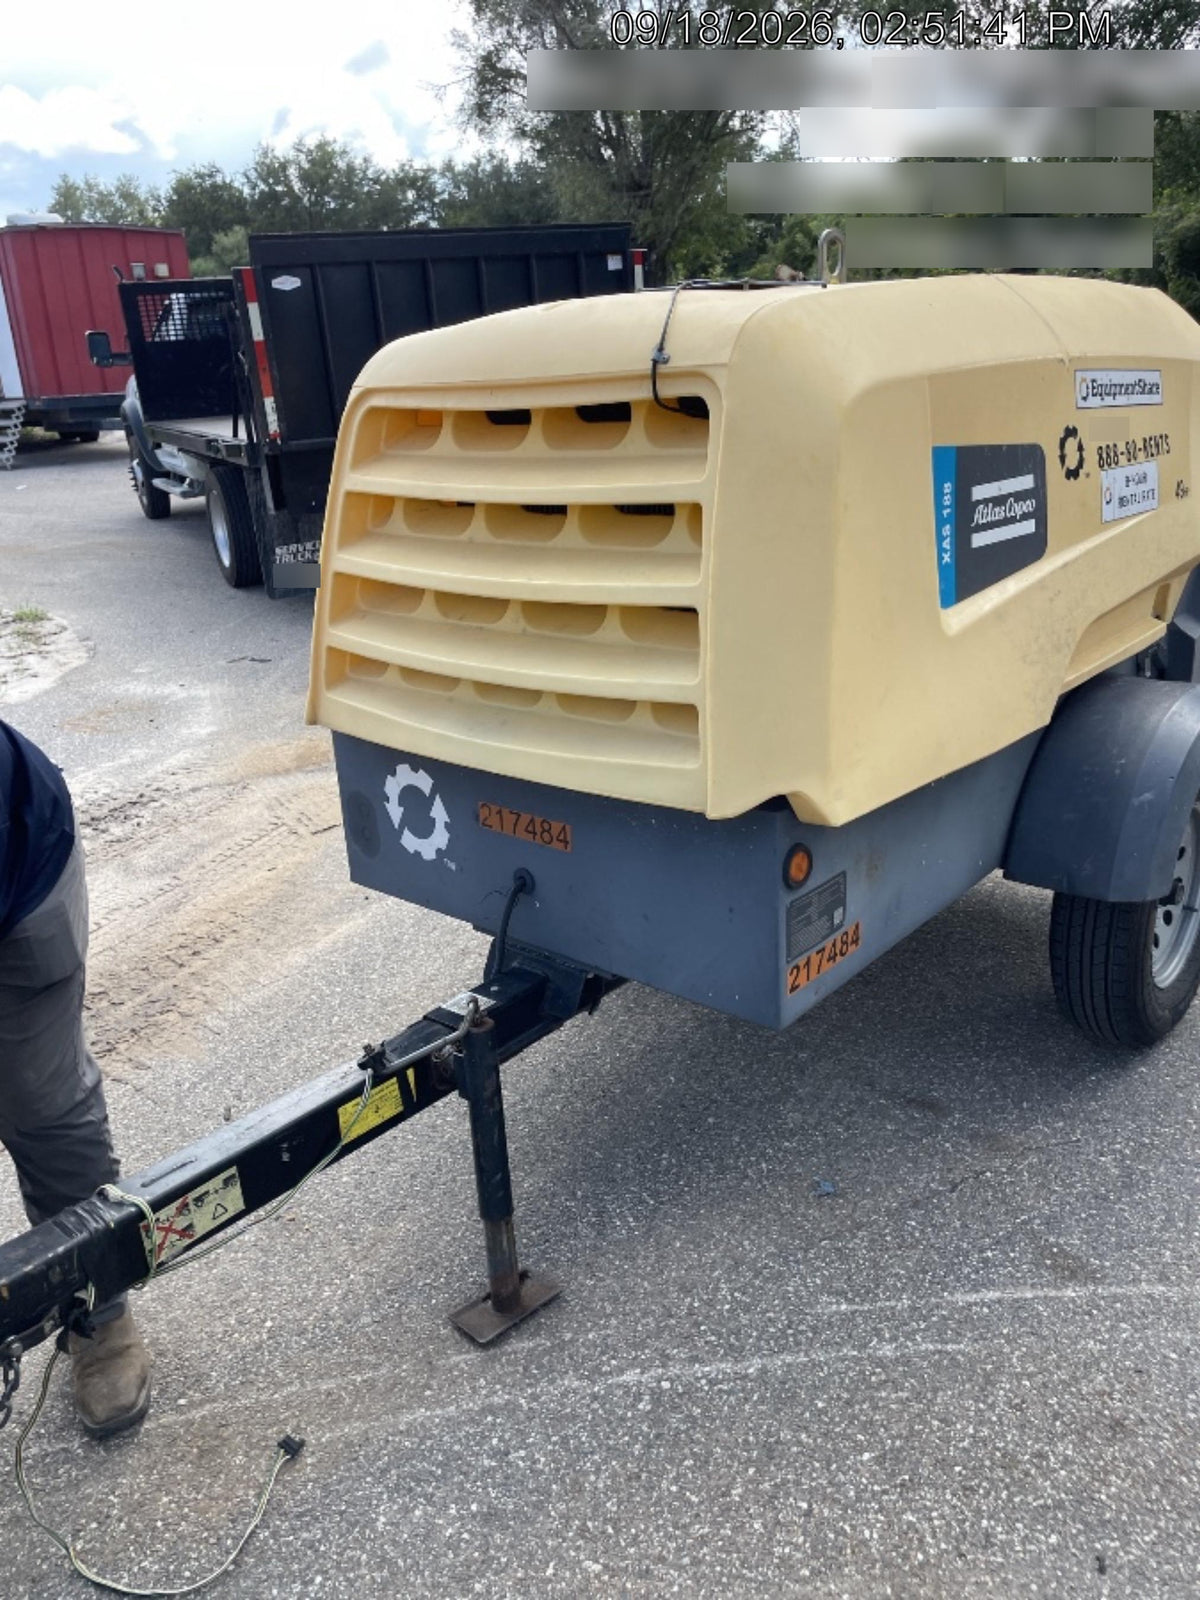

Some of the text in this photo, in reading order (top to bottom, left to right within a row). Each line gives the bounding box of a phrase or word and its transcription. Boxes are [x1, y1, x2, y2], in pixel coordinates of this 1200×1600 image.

[1091, 378, 1160, 401] EquipmentShare
[970, 497, 1037, 527] Atlas Copco
[942, 524, 952, 565] XAS
[480, 802, 570, 851] 217484
[789, 921, 860, 994] 217484
